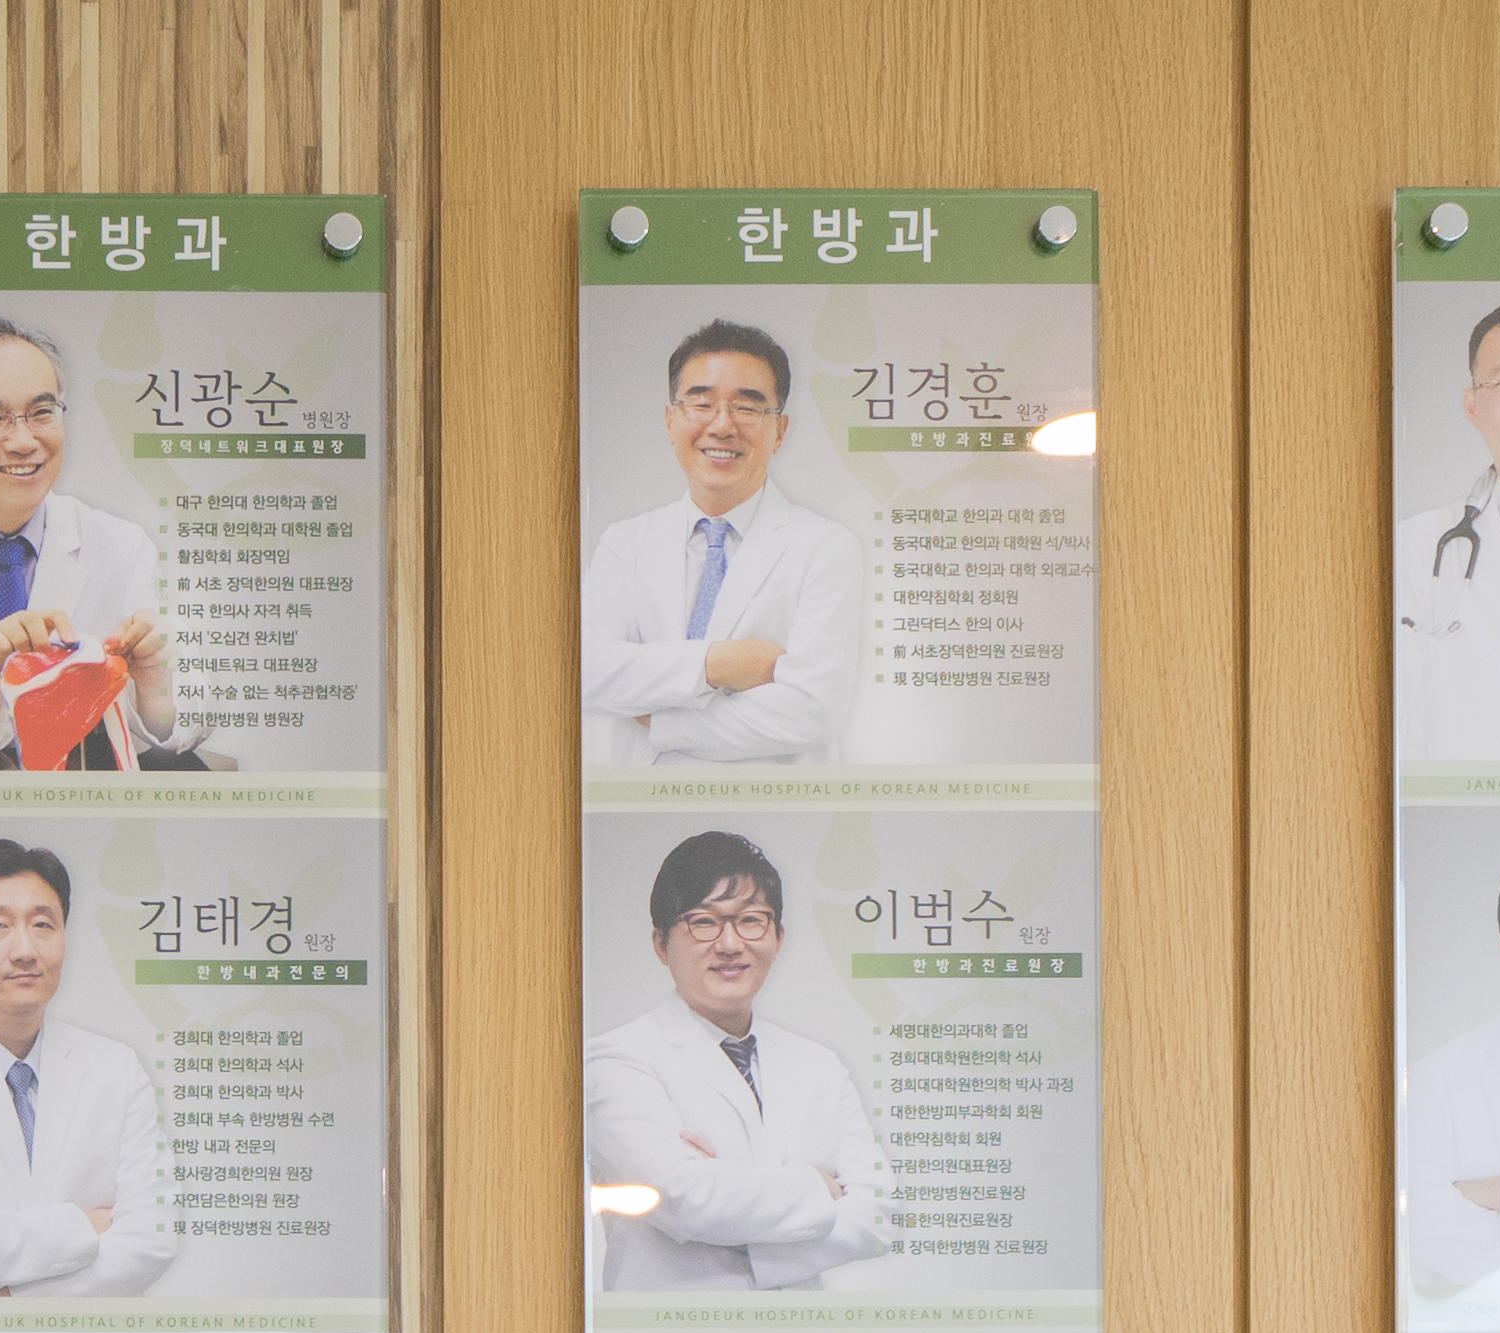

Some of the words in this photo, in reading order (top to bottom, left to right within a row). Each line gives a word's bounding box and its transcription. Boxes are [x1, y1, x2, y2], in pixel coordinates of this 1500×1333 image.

[24, 214, 227, 272] 한방과
[736, 207, 939, 264] 한방과
[135, 369, 298, 429] 신광순
[302, 410, 352, 430] 병원장
[851, 362, 1012, 422] 김경훈
[1016, 403, 1051, 425] 원장
[160, 439, 344, 455] 장덕네트워크대표원장
[175, 495, 203, 511] 대구
[207, 494, 248, 511] 한의대
[252, 494, 307, 511] 한의학과
[310, 495, 338, 511] 졸업
[890, 508, 959, 526] 동국대학교
[962, 508, 1004, 524] 한의과
[1007, 508, 1035, 524] 대학
[1038, 508, 1066, 525] 졸업
[32, 789, 114, 802] HOSPITAL
[123, 789, 144, 802] OF
[153, 790, 222, 802] KOREAN
[231, 790, 315, 802] MEDICINE
[138, 895, 293, 955] 김태경
[303, 933, 337, 953] 원장
[854, 888, 1015, 947] 이범수
[1018, 926, 1052, 946] 원장
[197, 965, 349, 981] 한방내과전문의
[913, 958, 1065, 974] 한방과진료원장
